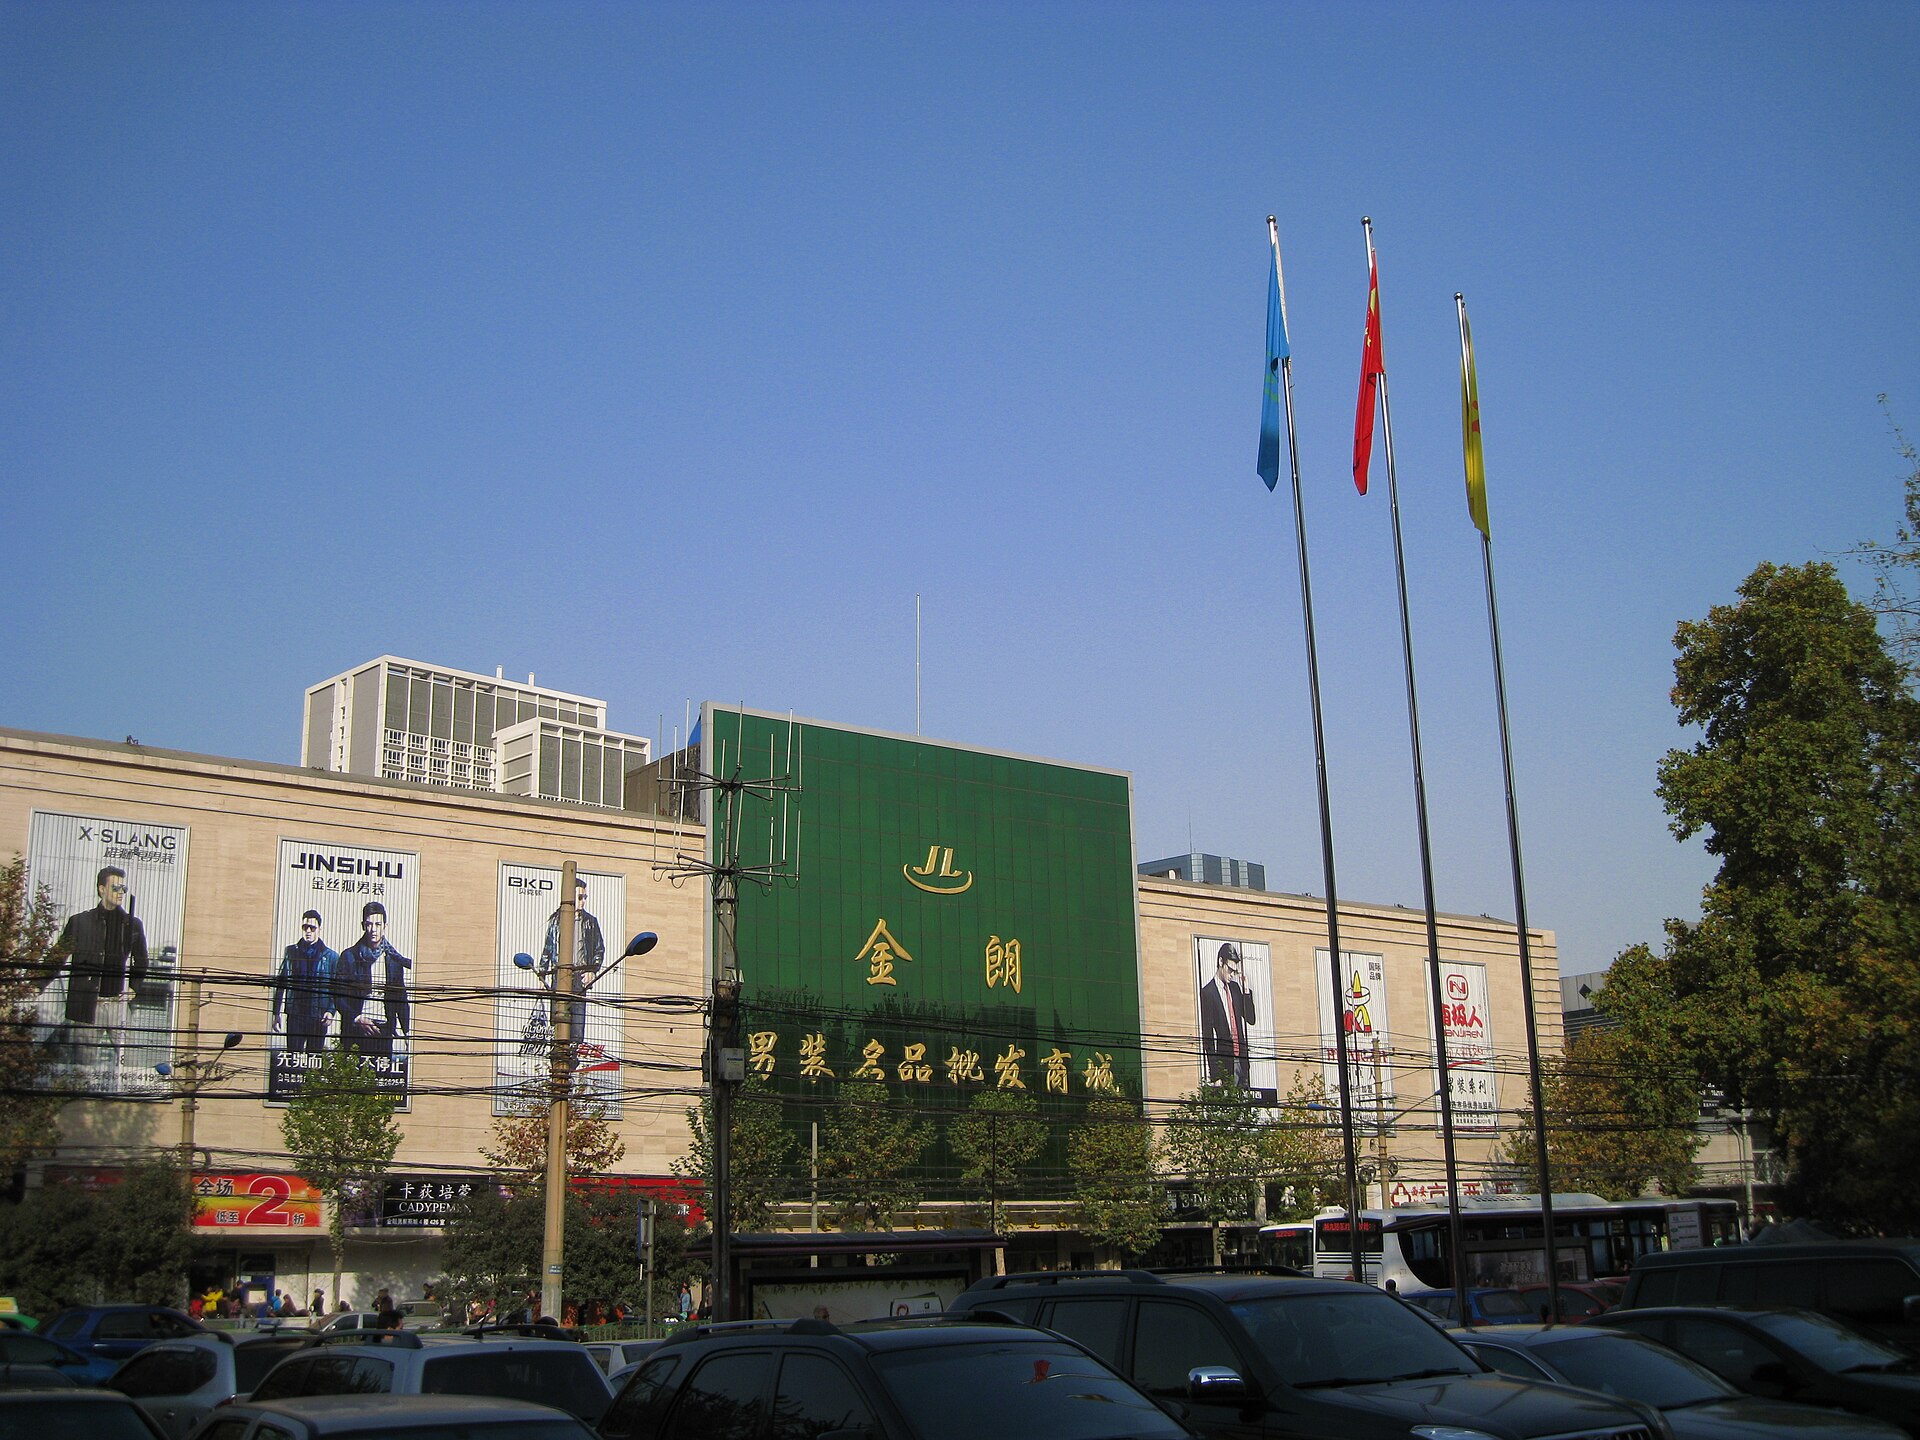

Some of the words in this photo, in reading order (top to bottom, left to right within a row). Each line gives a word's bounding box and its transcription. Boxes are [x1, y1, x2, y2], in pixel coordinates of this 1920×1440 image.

[78, 825, 177, 850] X-SLANG
[291, 852, 403, 879] JINSIHU
[311, 876, 385, 896] 金丝狐男装
[508, 876, 553, 891] BKD
[854, 918, 1024, 994] 金朗
[197, 1178, 234, 1197] 全场
[216, 1210, 239, 1224] 低至
[245, 1175, 291, 1226] 2
[293, 1213, 306, 1226] 折
